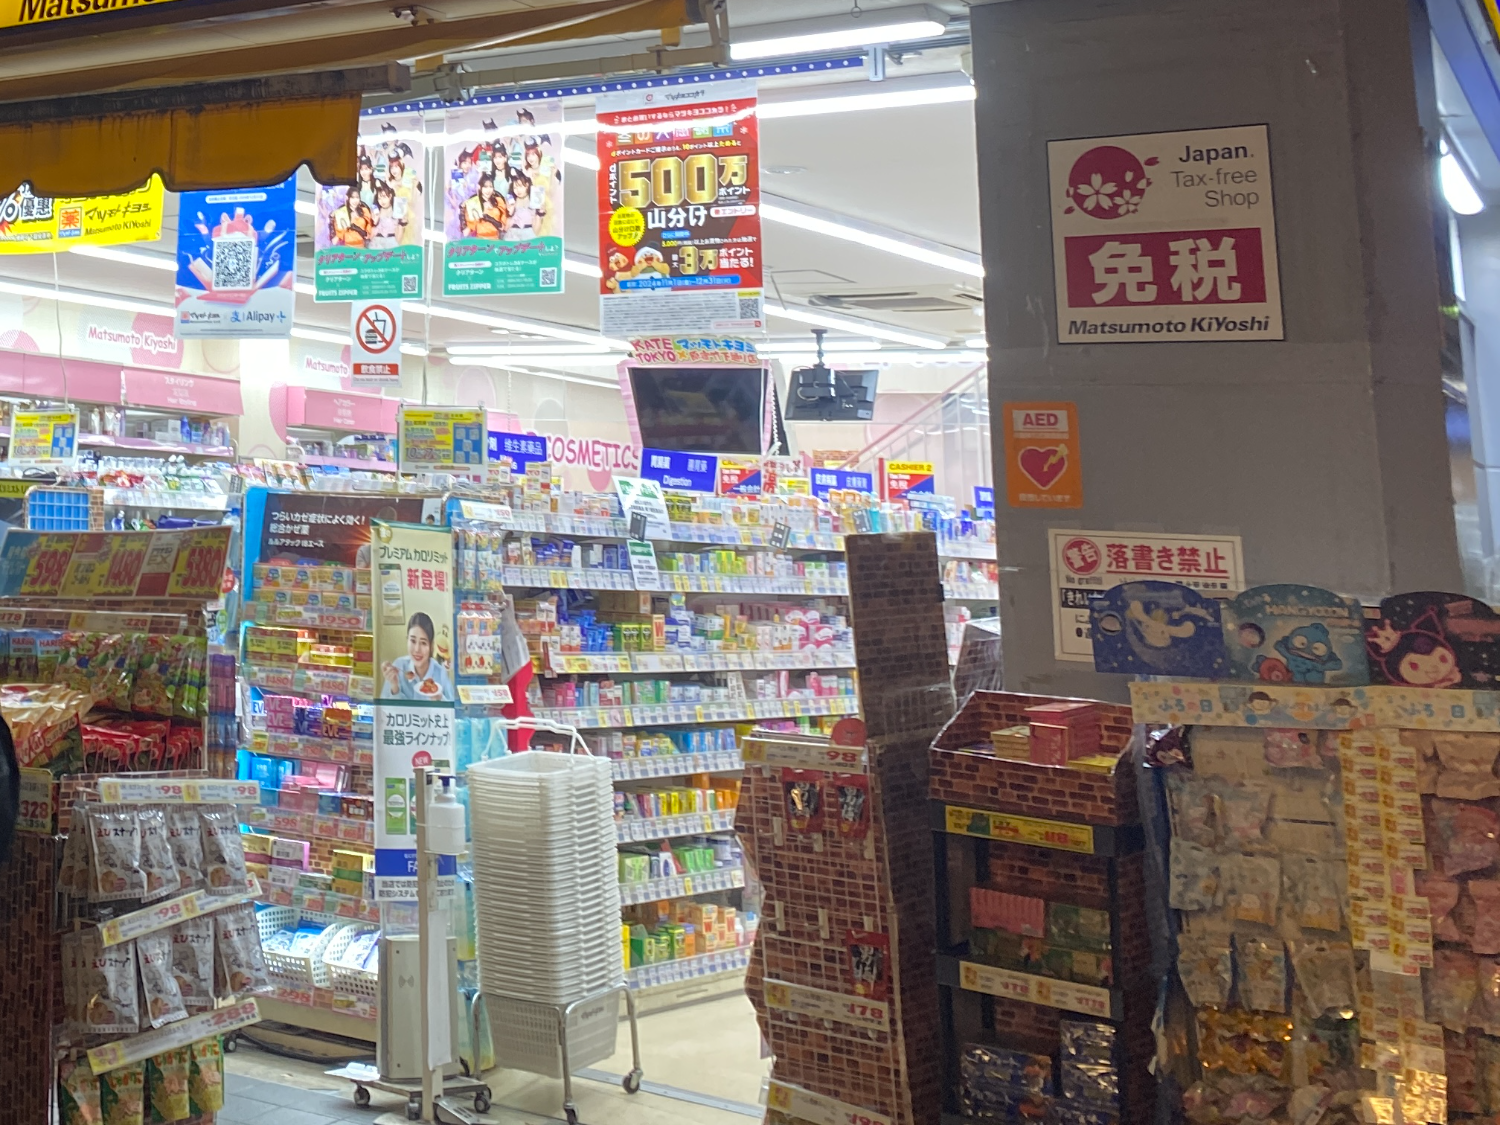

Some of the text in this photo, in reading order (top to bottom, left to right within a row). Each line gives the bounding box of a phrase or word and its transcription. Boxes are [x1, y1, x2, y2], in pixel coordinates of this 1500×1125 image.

[1170, 168, 1258, 188] Tax-free
[718, 187, 751, 196] ポイント
[1204, 189, 1260, 209] Shop
[647, 205, 707, 230] 山分け
[85, 224, 122, 236] Matsumoto
[719, 247, 754, 256] ポイント
[679, 245, 719, 275] 3万
[1088, 236, 1242, 305] 免税
[246, 312, 275, 324] Alipay
[1068, 316, 1270, 335] Matsumoto KiYoshi
[88, 326, 177, 352] Matsumoto Kiyoshi
[630, 337, 674, 352] KATE
[636, 350, 677, 363] TOKYO
[305, 356, 349, 375] Matsumoto
[164, 376, 195, 388] スタイリング
[1022, 412, 1059, 427] AED
[547, 435, 638, 471] OSMETICS
[889, 463, 932, 472] CASHIER 2
[378, 546, 448, 564] プレミアム カロリミット
[1106, 543, 1229, 574] 落書き禁止
[318, 614, 361, 626] 1950
[12, 636, 35, 646] HARIBO
[386, 713, 449, 729] カロリミット史上
[322, 724, 340, 737] EVE
[414, 755, 430, 765] NEW
[20, 800, 49, 819] 328
[211, 1002, 256, 1025] 288
